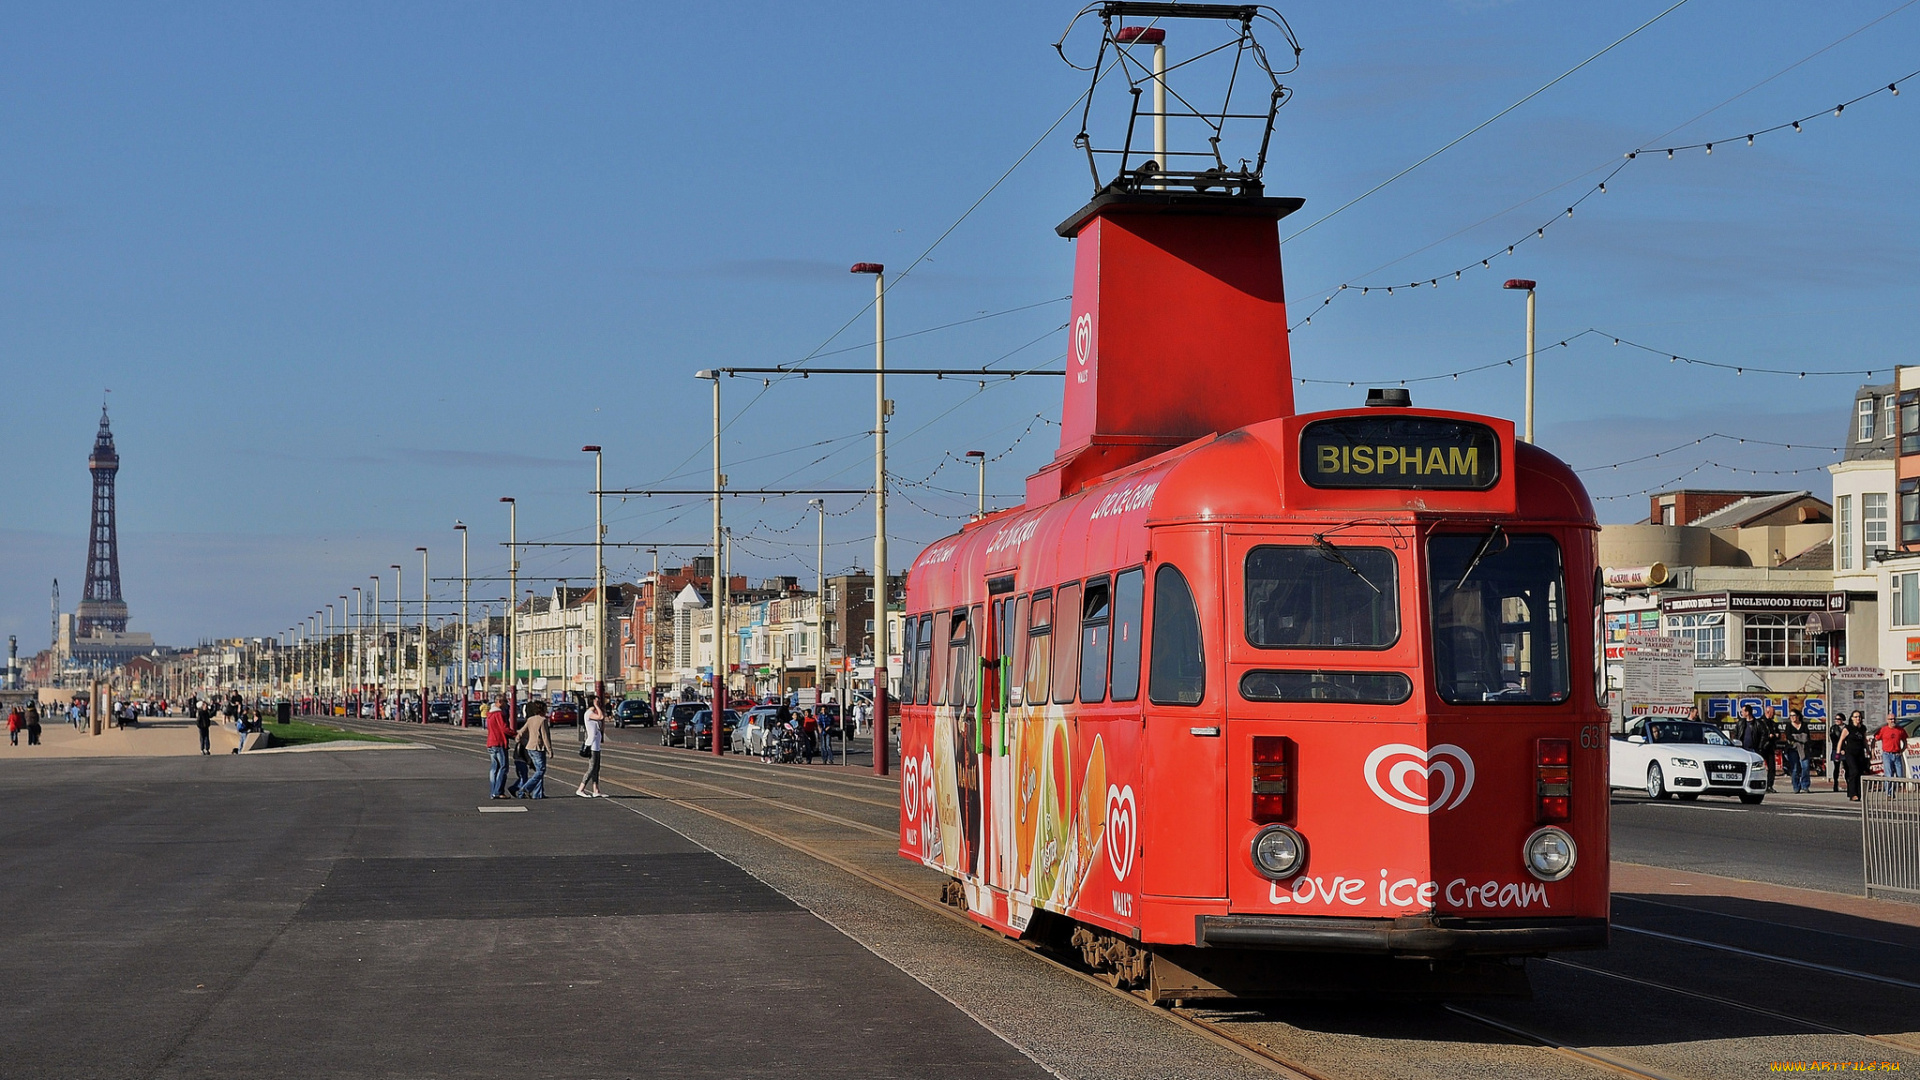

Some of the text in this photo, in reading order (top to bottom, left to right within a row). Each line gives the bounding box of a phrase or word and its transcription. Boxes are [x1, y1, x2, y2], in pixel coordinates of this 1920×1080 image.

[1318, 445, 1477, 475] BISPHAM
[1731, 597, 1791, 607] INGLEWOOD
[1793, 598, 1825, 607] HOTEL
[1831, 596, 1842, 608] 419
[1632, 704, 1690, 715] HOT DO-NUTS
[1708, 698, 1826, 718] FISH &
[1581, 725, 1605, 749] 631
[1269, 876, 1367, 905] Love
[1379, 868, 1439, 907] ice
[1112, 889, 1133, 918] WALL'S
